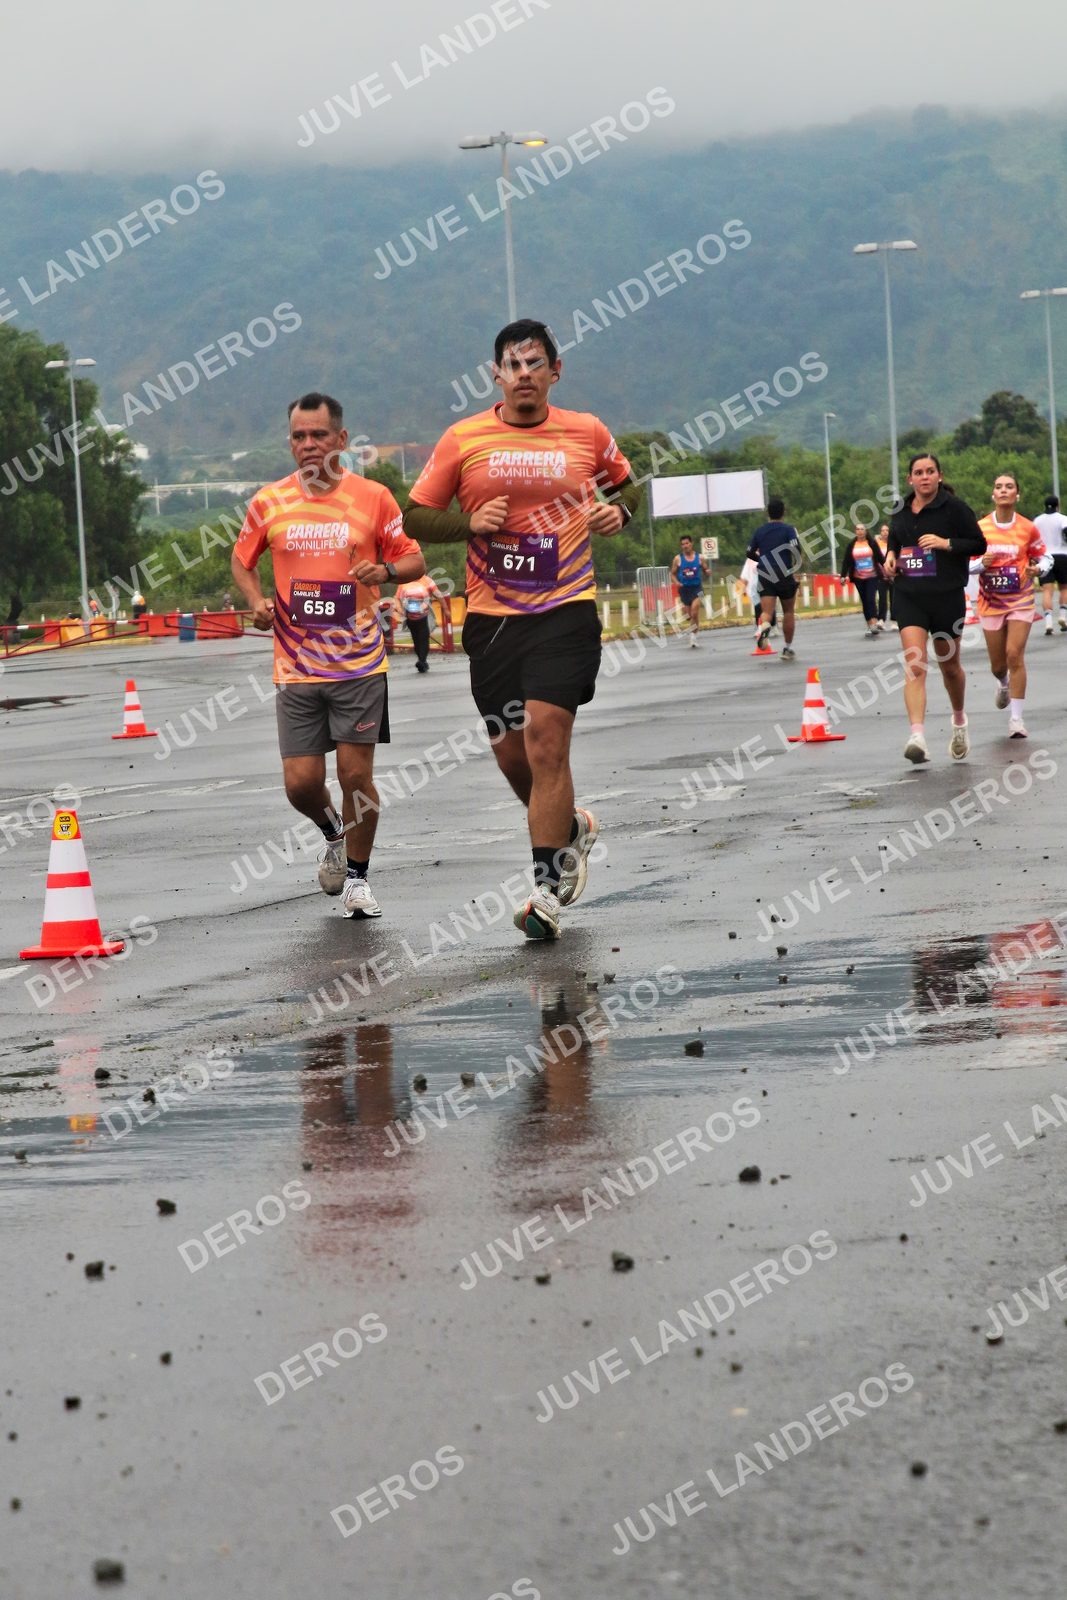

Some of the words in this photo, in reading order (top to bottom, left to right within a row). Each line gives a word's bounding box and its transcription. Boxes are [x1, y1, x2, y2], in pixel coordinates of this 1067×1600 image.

[489, 451, 566, 466] CARRERA
[286, 522, 349, 539] CARRERA
[504, 554, 535, 572] 671
[906, 559, 923, 568] 155
[992, 576, 1008, 585] 122
[304, 600, 335, 615] 658
